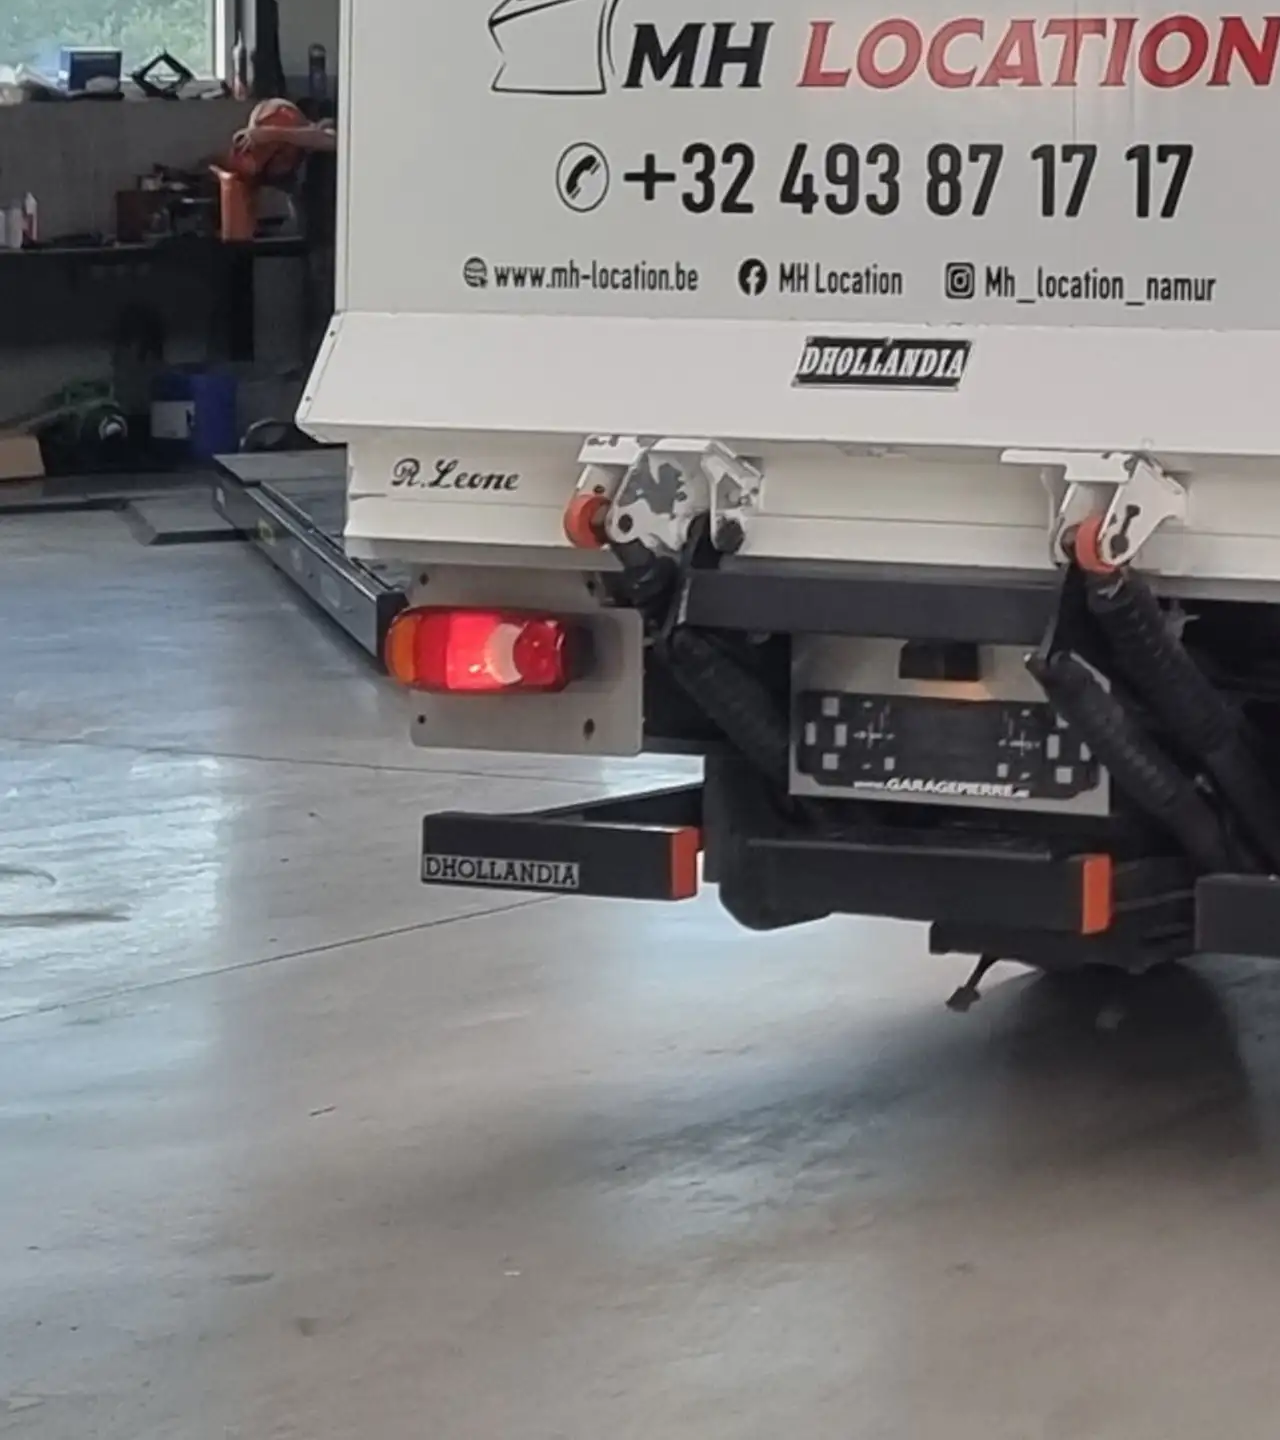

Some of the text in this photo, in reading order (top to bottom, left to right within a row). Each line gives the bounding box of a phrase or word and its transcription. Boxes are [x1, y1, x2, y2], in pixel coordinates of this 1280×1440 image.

[622, 20, 775, 89] MH
[623, 142, 1194, 219] +32 493 87 17 17
[494, 259, 699, 292] www.mh-location.be
[778, 262, 903, 296] MH Location
[985, 265, 1217, 307] Mh_location_namur
[800, 345, 965, 379] DHOLLANDIA
[425, 856, 576, 886] DHOLLANDIA
